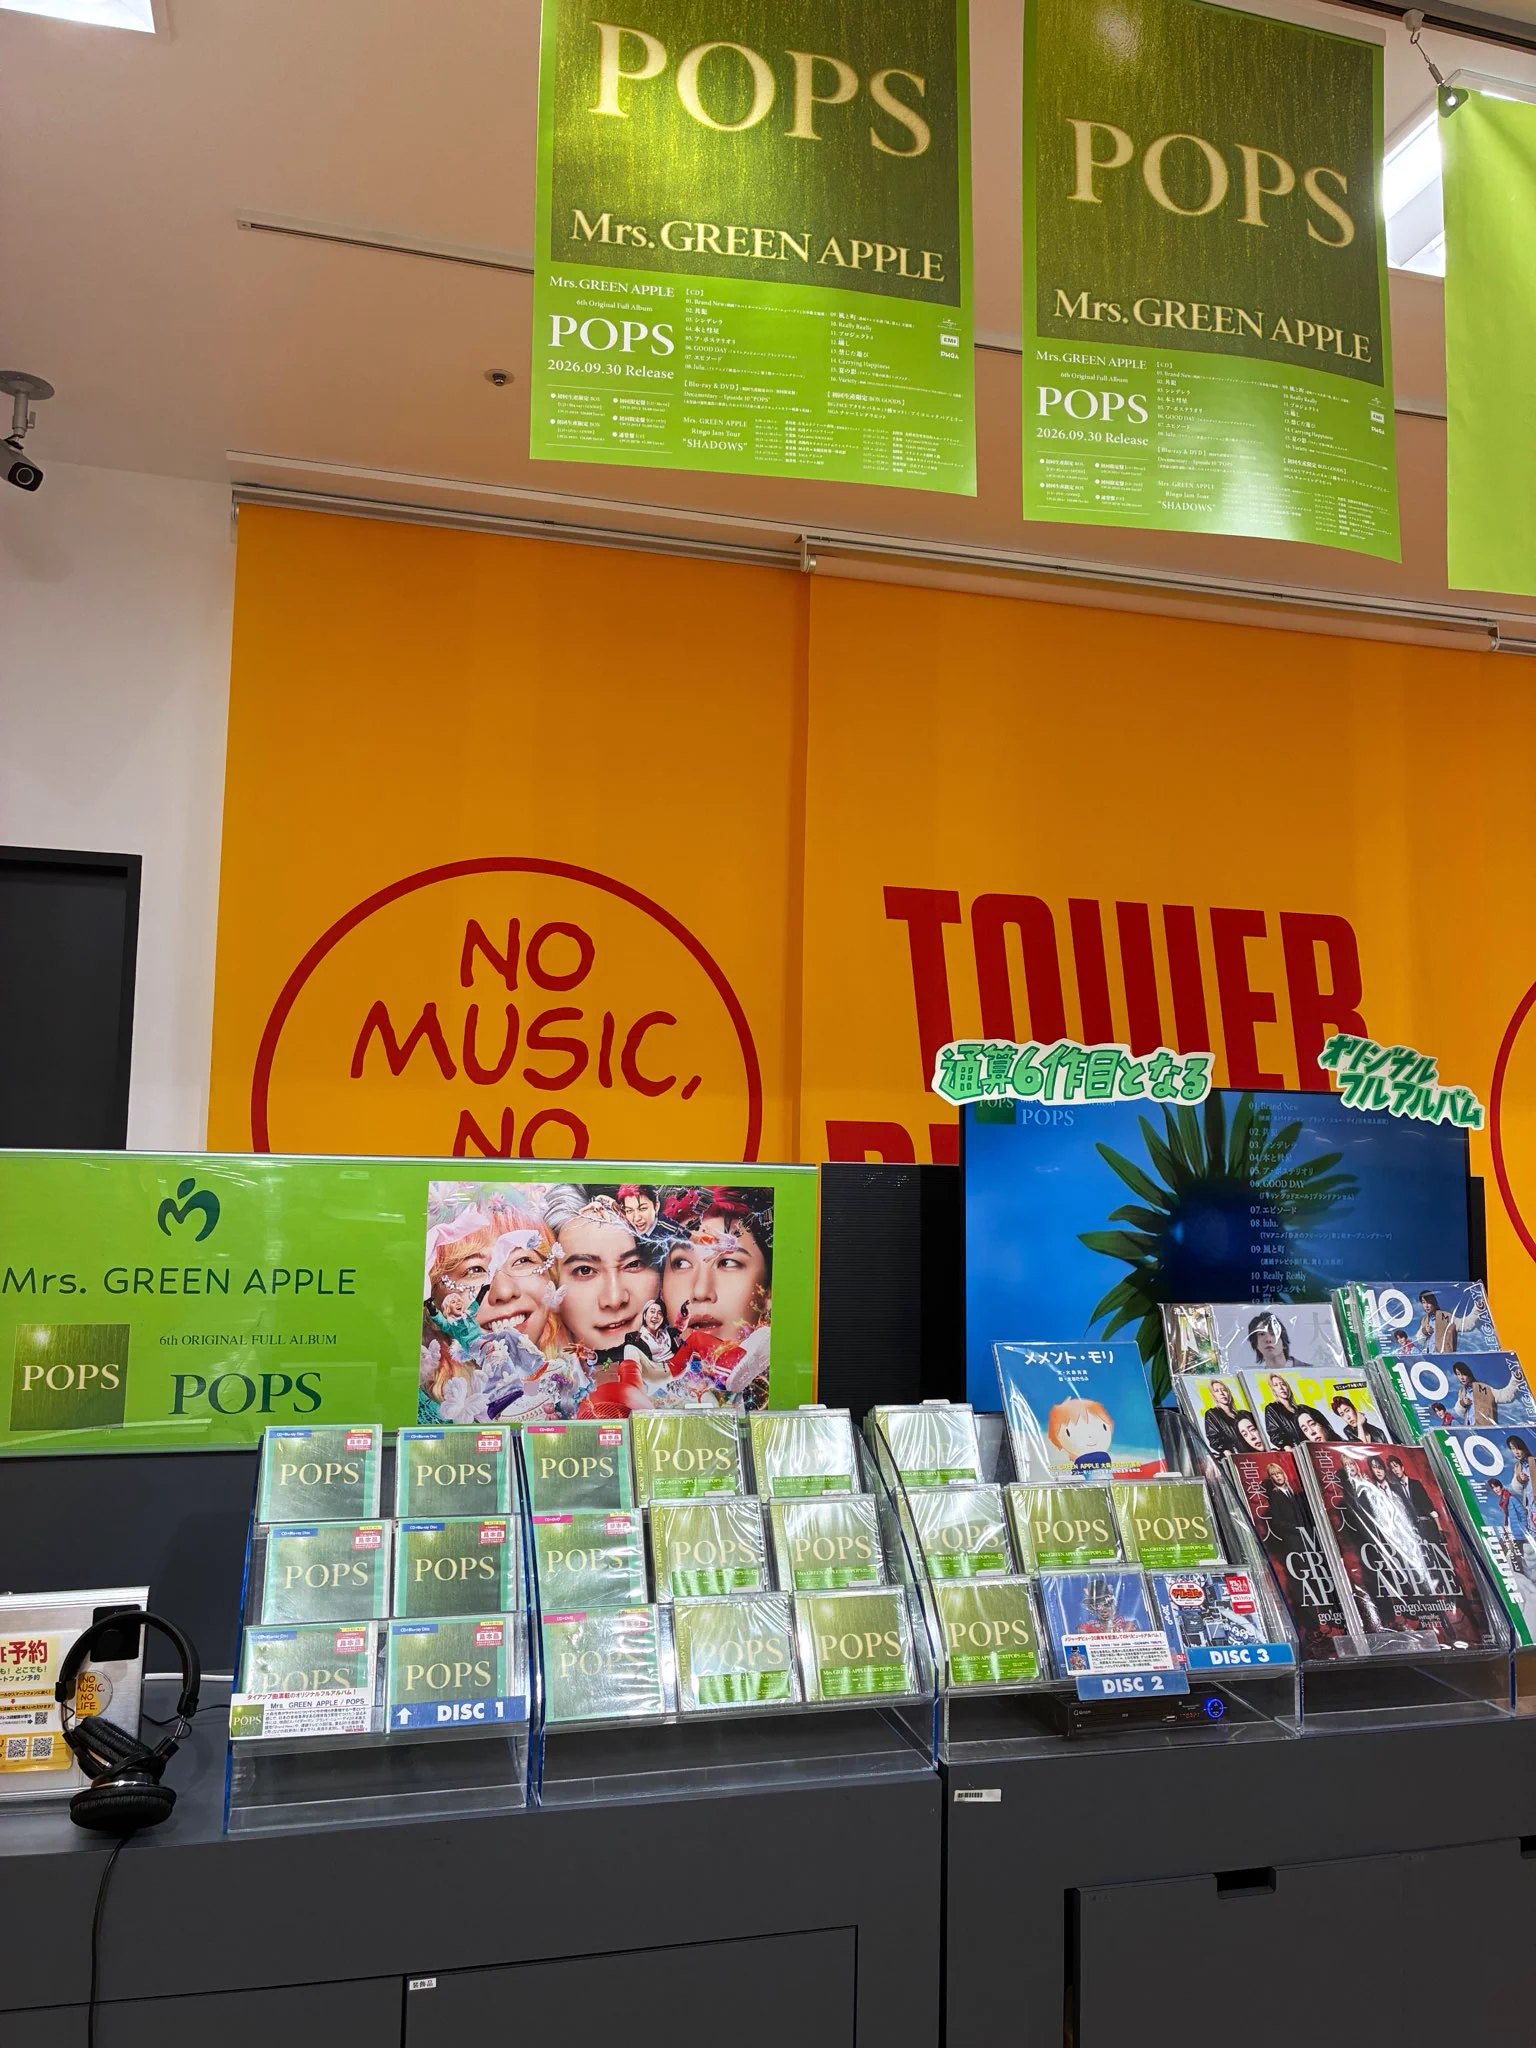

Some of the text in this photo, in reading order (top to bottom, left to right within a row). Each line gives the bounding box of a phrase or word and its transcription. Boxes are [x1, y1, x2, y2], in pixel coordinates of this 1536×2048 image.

[589, 20, 931, 158] POPS
[1066, 117, 1355, 248] POPS
[570, 209, 945, 282] Mrs. GREEN APPLE
[550, 276, 675, 298] Mrs. GREEN APPLE
[589, 300, 616, 309] Original
[617, 302, 630, 310] Full
[631, 304, 653, 312] Album
[548, 314, 675, 356] POPS
[1053, 288, 1372, 364] Mrs. GREEN APPLE
[547, 359, 674, 380] 2026.09.30 Release
[1036, 351, 1147, 370] Mrs. GREEN APPLE
[1071, 373, 1095, 381] Original
[1109, 376, 1128, 384] Album
[1036, 386, 1148, 424] POPS
[1036, 428, 1149, 446] 2026.09.30 Release
[460, 918, 595, 992] NO
[883, 885, 1369, 1092] TOWER
[350, 1000, 702, 1099] MUSIC,
[1321, 1034, 1438, 1084] オリジナル
[940, 1043, 1209, 1101] 通算6作目となる
[1339, 1073, 1484, 1128] フルアルバム
[1022, 1109, 1075, 1127] POPS
[452, 1107, 590, 1159] NO
[1263, 1180, 1305, 1188] GOOD DAY
[1250, 1206, 1297, 1215] 07. エピソード
[1250, 1219, 1261, 1227] 08.
[1250, 1245, 1262, 1253] 09.
[2, 1267, 357, 1295] Mrs. GREEN APPLE
[1263, 1271, 1284, 1281] Really
[1285, 1271, 1306, 1281] Really
[1362, 1289, 1414, 1328] 10
[159, 1333, 338, 1346] 6th ORIGINAL FULL ALBUM
[1024, 1351, 1114, 1366] メメント・モリ
[21, 1363, 120, 1392] POPS
[1392, 1361, 1449, 1401] 10
[168, 1372, 322, 1416] POPS
[540, 1456, 614, 1479] POPS
[653, 1447, 731, 1472] POPS
[1445, 1435, 1504, 1477] 10
[280, 1461, 359, 1486] POPS
[416, 1463, 492, 1487] POPS
[1239, 1460, 1283, 1542] 音楽と人
[1315, 1449, 1358, 1532] 音楽と人
[925, 1524, 999, 1550] POPS
[1035, 1519, 1109, 1544] POPS
[1136, 1516, 1208, 1541] POPS
[547, 1548, 623, 1573] POPS
[674, 1538, 757, 1565] POPS
[793, 1535, 872, 1562] POPS
[284, 1561, 369, 1589] POPS
[414, 1556, 495, 1582] POPS
[1481, 1525, 1524, 1604] FUTURE
[1375, 1569, 1463, 1598] APPLE
[820, 1631, 902, 1661] POPS
[949, 1620, 1029, 1648] POPS
[1209, 1648, 1270, 1665] DISC 3
[15, 1666, 47, 1675] どこでも！
[262, 1668, 351, 1692] POPS
[405, 1660, 491, 1691] POPS
[1103, 1676, 1164, 1694] DISC 2
[233, 1715, 262, 1726] POPS
[437, 1702, 504, 1722] DISC 1
